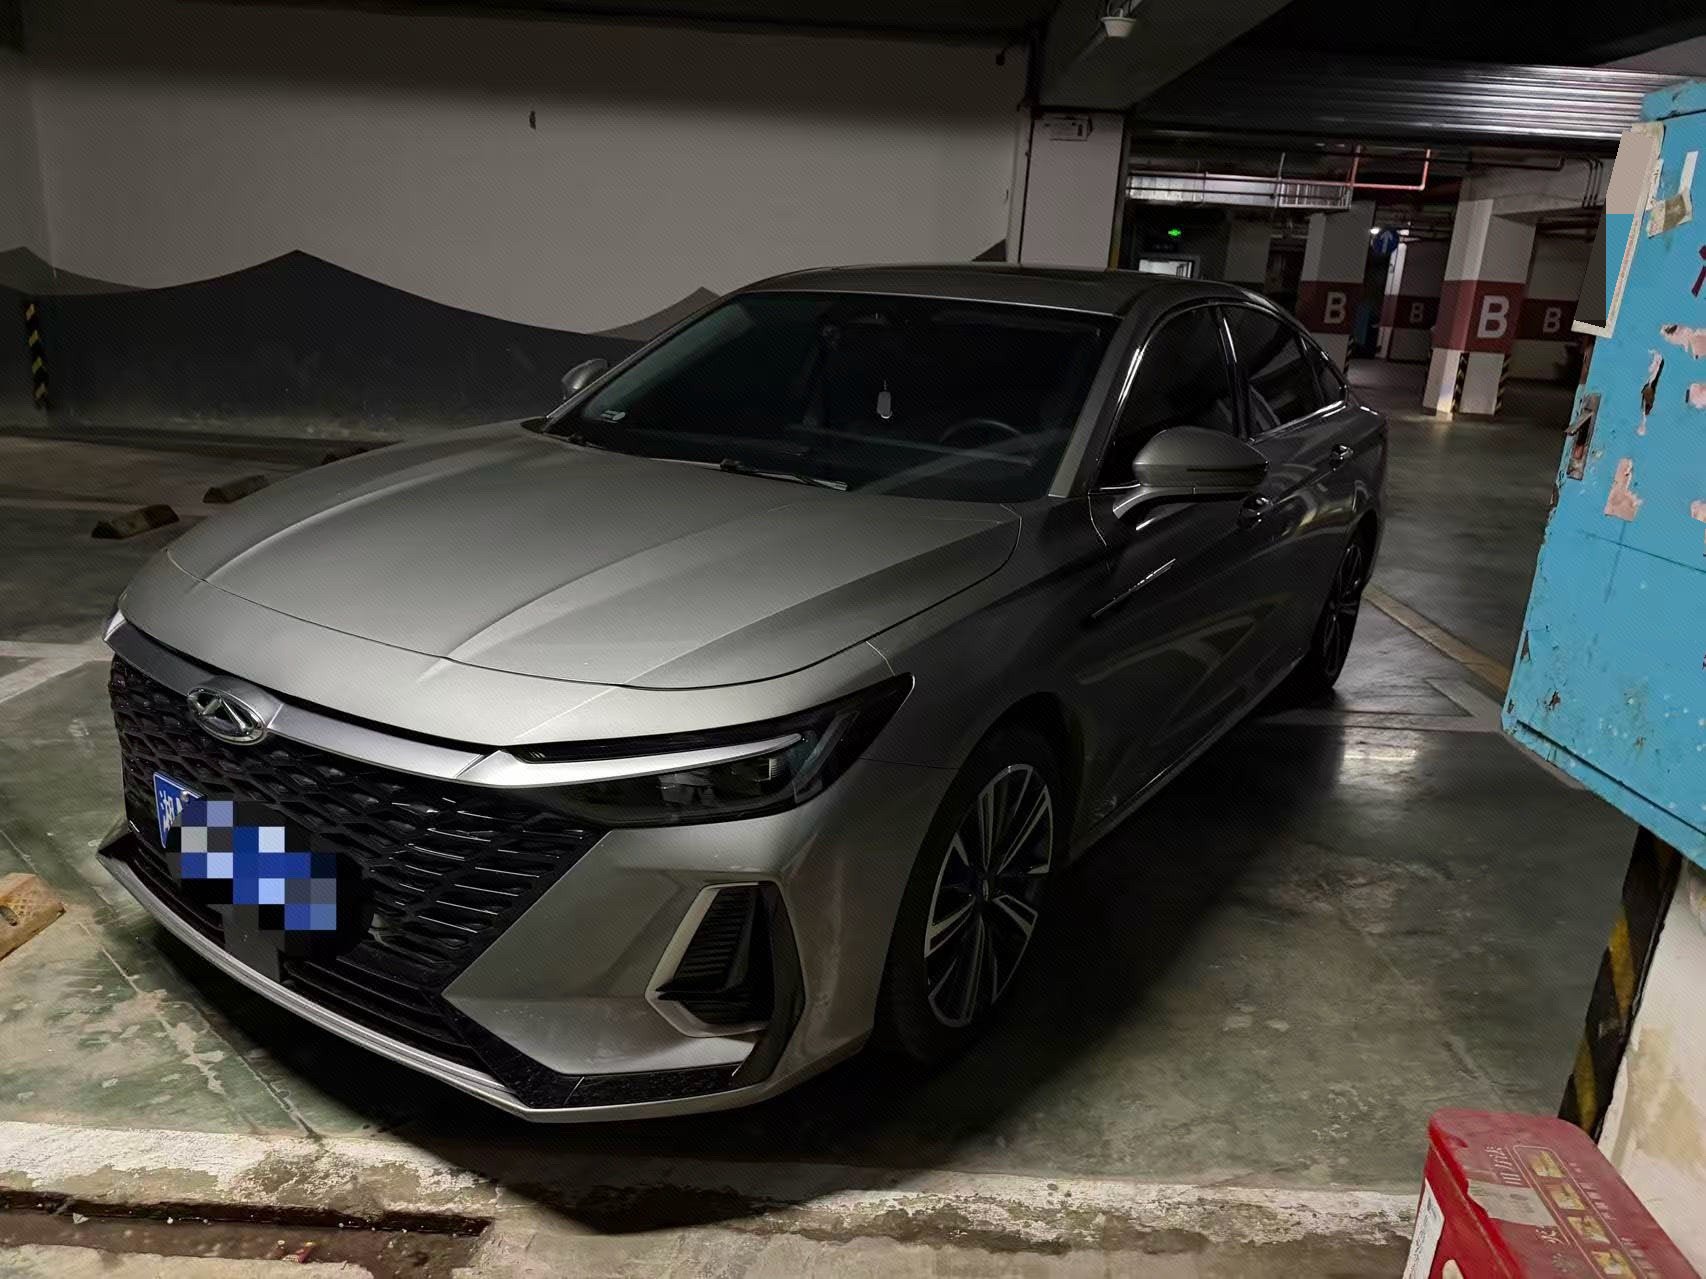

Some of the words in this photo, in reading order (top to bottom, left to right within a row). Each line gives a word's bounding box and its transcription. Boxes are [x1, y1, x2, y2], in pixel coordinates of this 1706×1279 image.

[1323, 291, 1347, 324] B
[1409, 302, 1425, 324] B
[1477, 295, 1510, 338] B
[1543, 307, 1562, 333] B
